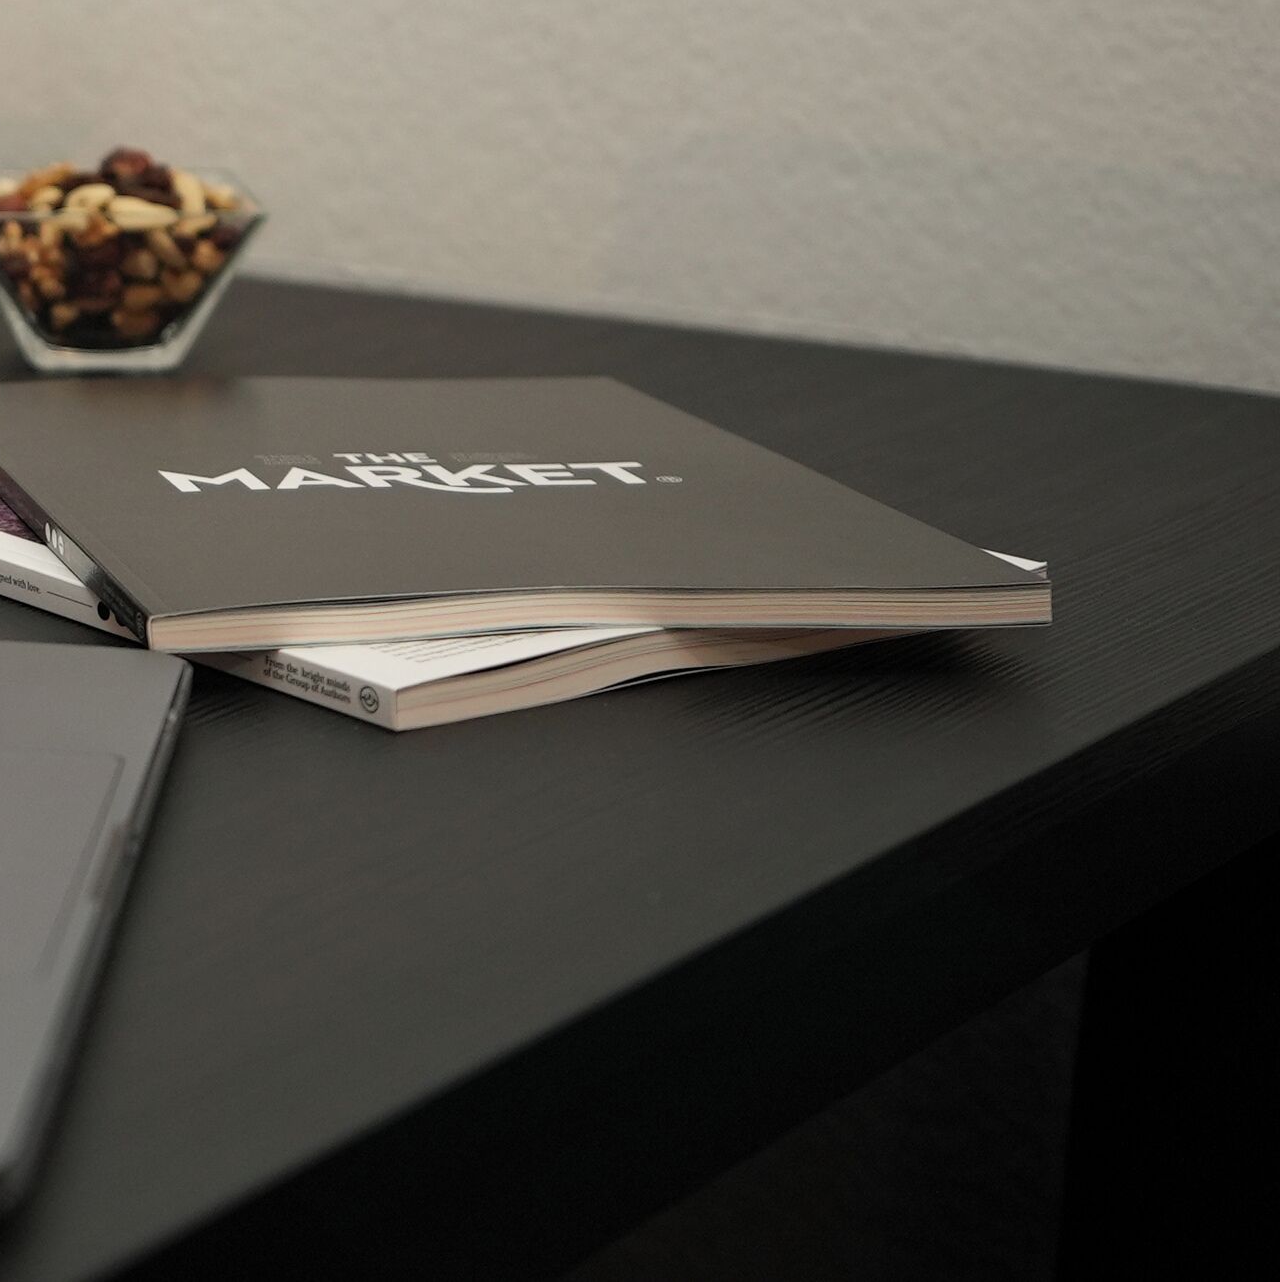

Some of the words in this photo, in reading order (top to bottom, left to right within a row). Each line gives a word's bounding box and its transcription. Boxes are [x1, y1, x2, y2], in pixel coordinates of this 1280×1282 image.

[333, 452, 437, 463] THE
[158, 461, 647, 494] MARKET
[13, 578, 27, 590] with
[263, 667, 271, 678] of
[272, 669, 285, 681] the
[286, 673, 310, 692] Group
[311, 684, 320, 693] of
[321, 686, 351, 704] Authors
[265, 654, 285, 670] From
[286, 662, 299, 674] the
[302, 667, 325, 684] bright
[326, 678, 351, 693] minds
